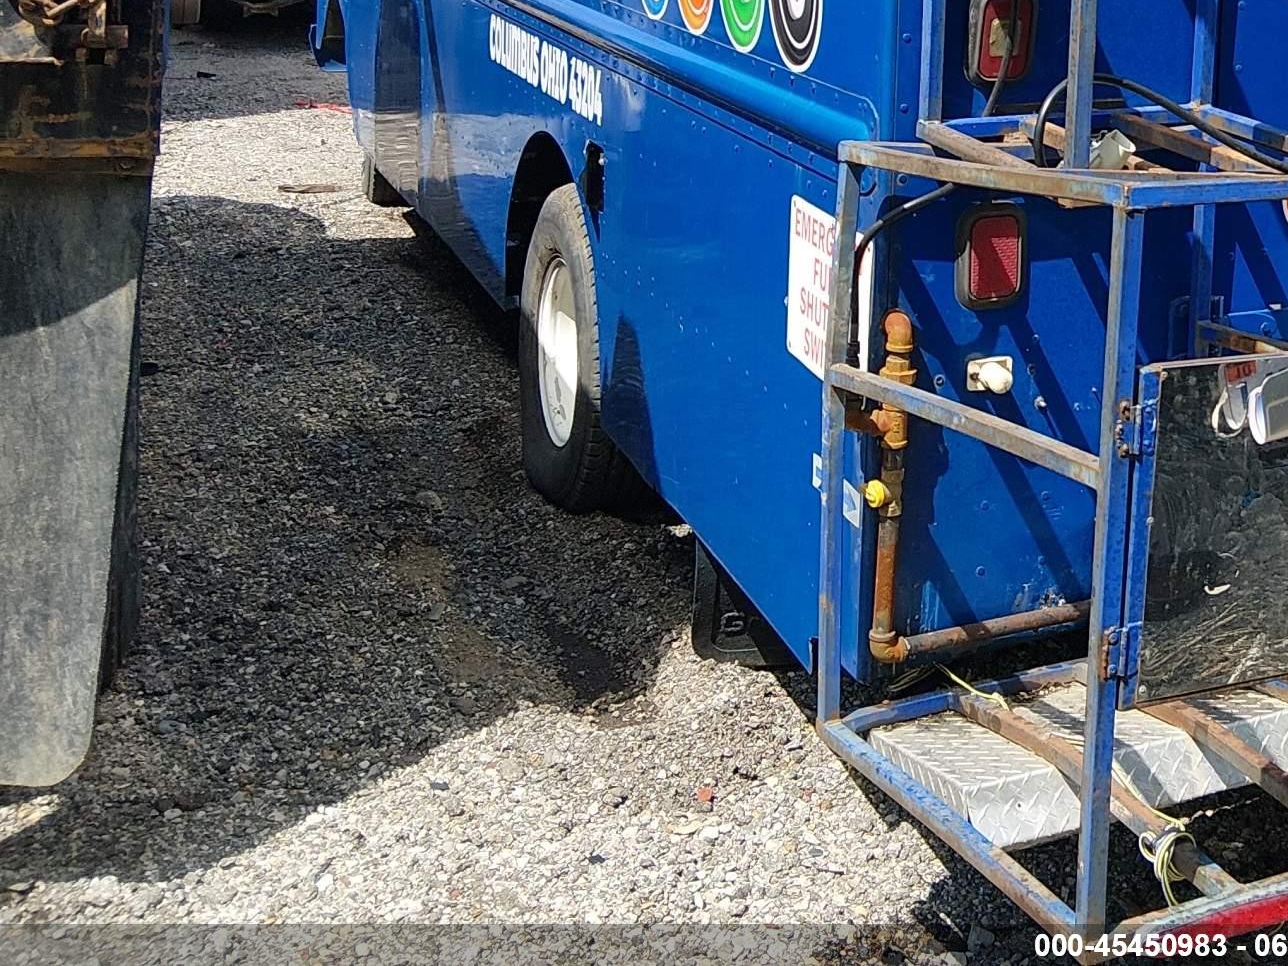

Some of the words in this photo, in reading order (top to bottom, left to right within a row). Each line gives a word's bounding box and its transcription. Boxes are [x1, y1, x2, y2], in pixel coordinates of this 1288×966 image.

[489, 13, 540, 88] COLUMBUS
[540, 40, 568, 105] OHIO
[569, 56, 602, 127] 43204
[795, 208, 835, 256] EMERG
[813, 258, 832, 291] FU
[804, 328, 825, 369] SWI
